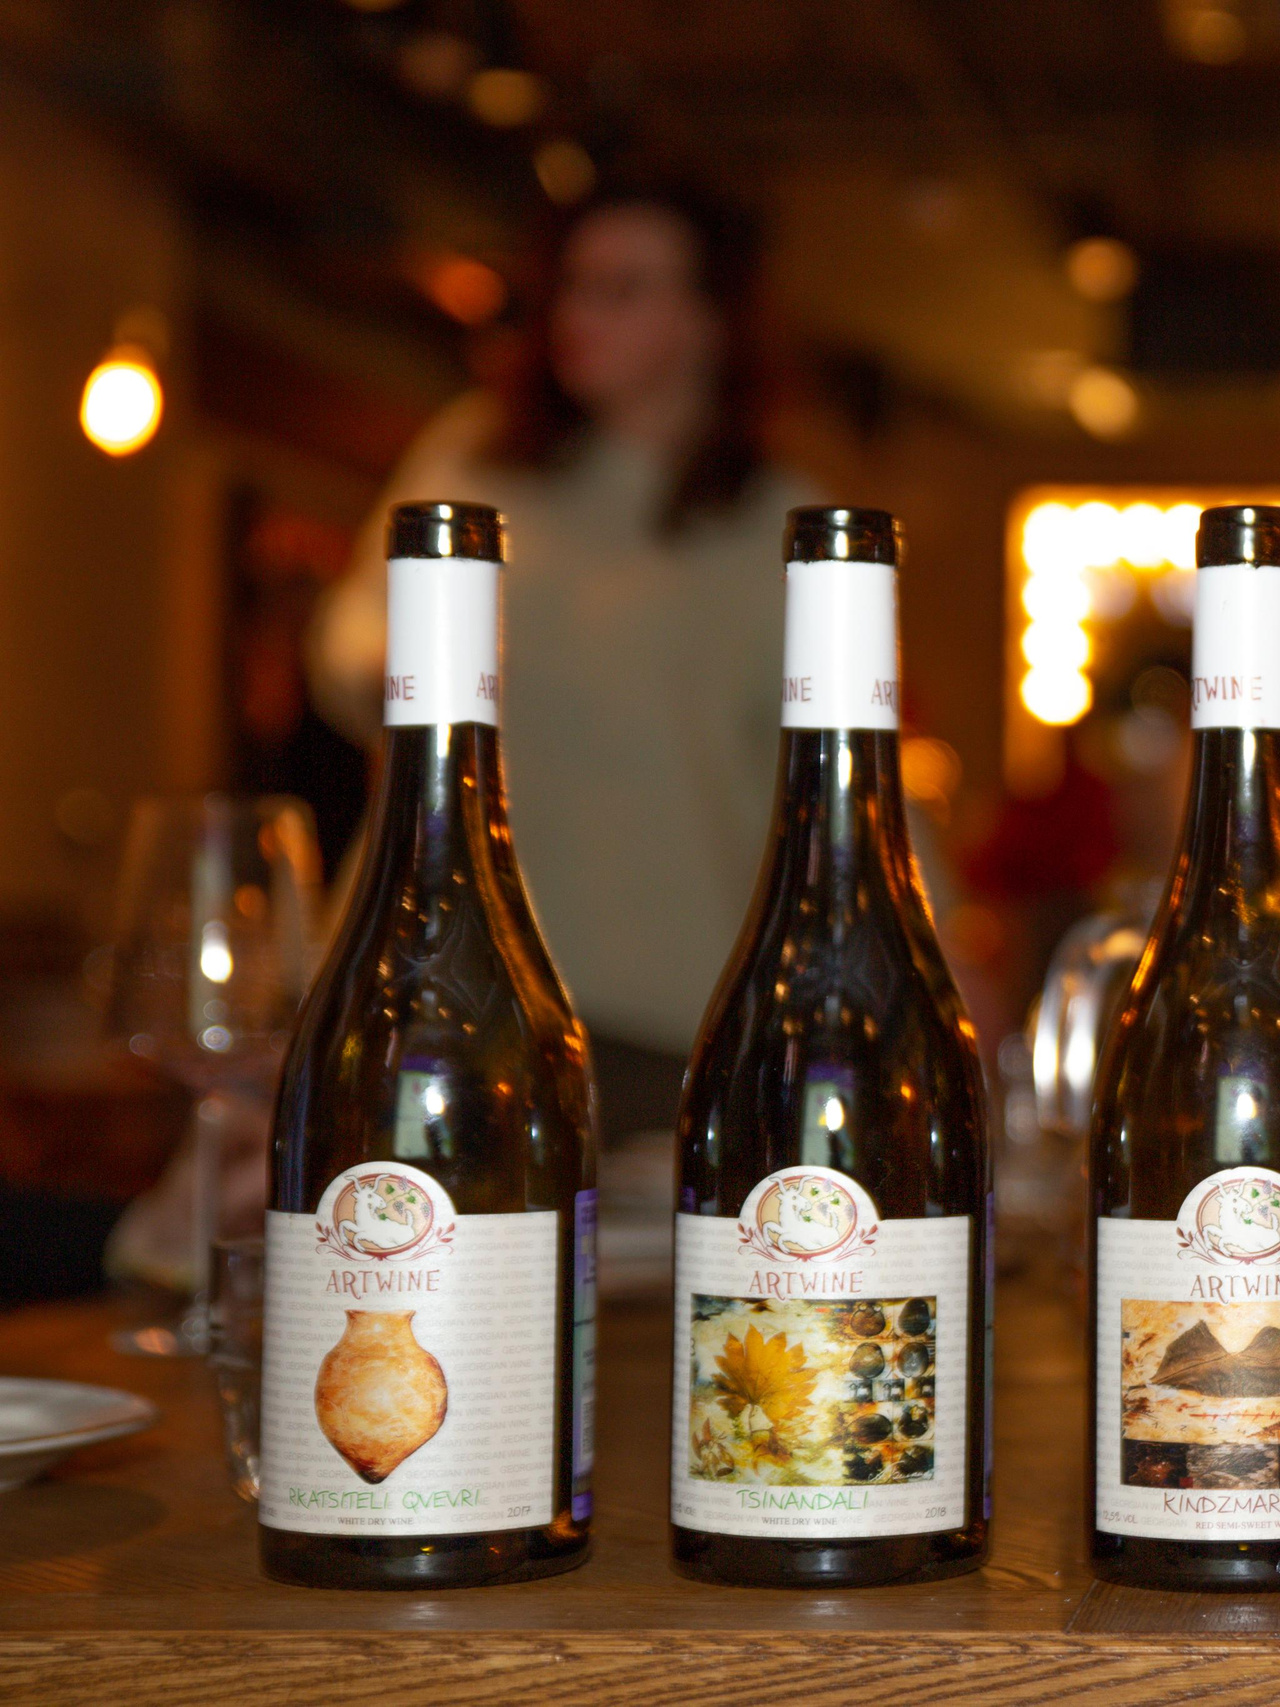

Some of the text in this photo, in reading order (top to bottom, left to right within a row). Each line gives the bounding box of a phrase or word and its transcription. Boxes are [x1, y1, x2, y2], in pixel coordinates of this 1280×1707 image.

[382, 675, 414, 700] INE
[781, 677, 812, 702] INE
[325, 1269, 440, 1300] ARTWINE
[748, 1270, 864, 1300] ARTWINE
[289, 1488, 485, 1515] RKATSITELI QVEVRI
[736, 1489, 869, 1511] TSINANDALI
[338, 1516, 414, 1526] WHITE DRY WINE
[507, 1505, 532, 1519] 2017
[762, 1516, 838, 1526] WHITE DRY WINE
[925, 1506, 947, 1519] 2018
[1122, 1514, 1138, 1524] VOL
[1195, 1522, 1214, 1530] RED
[1216, 1520, 1272, 1530] SEMI-SWEET
